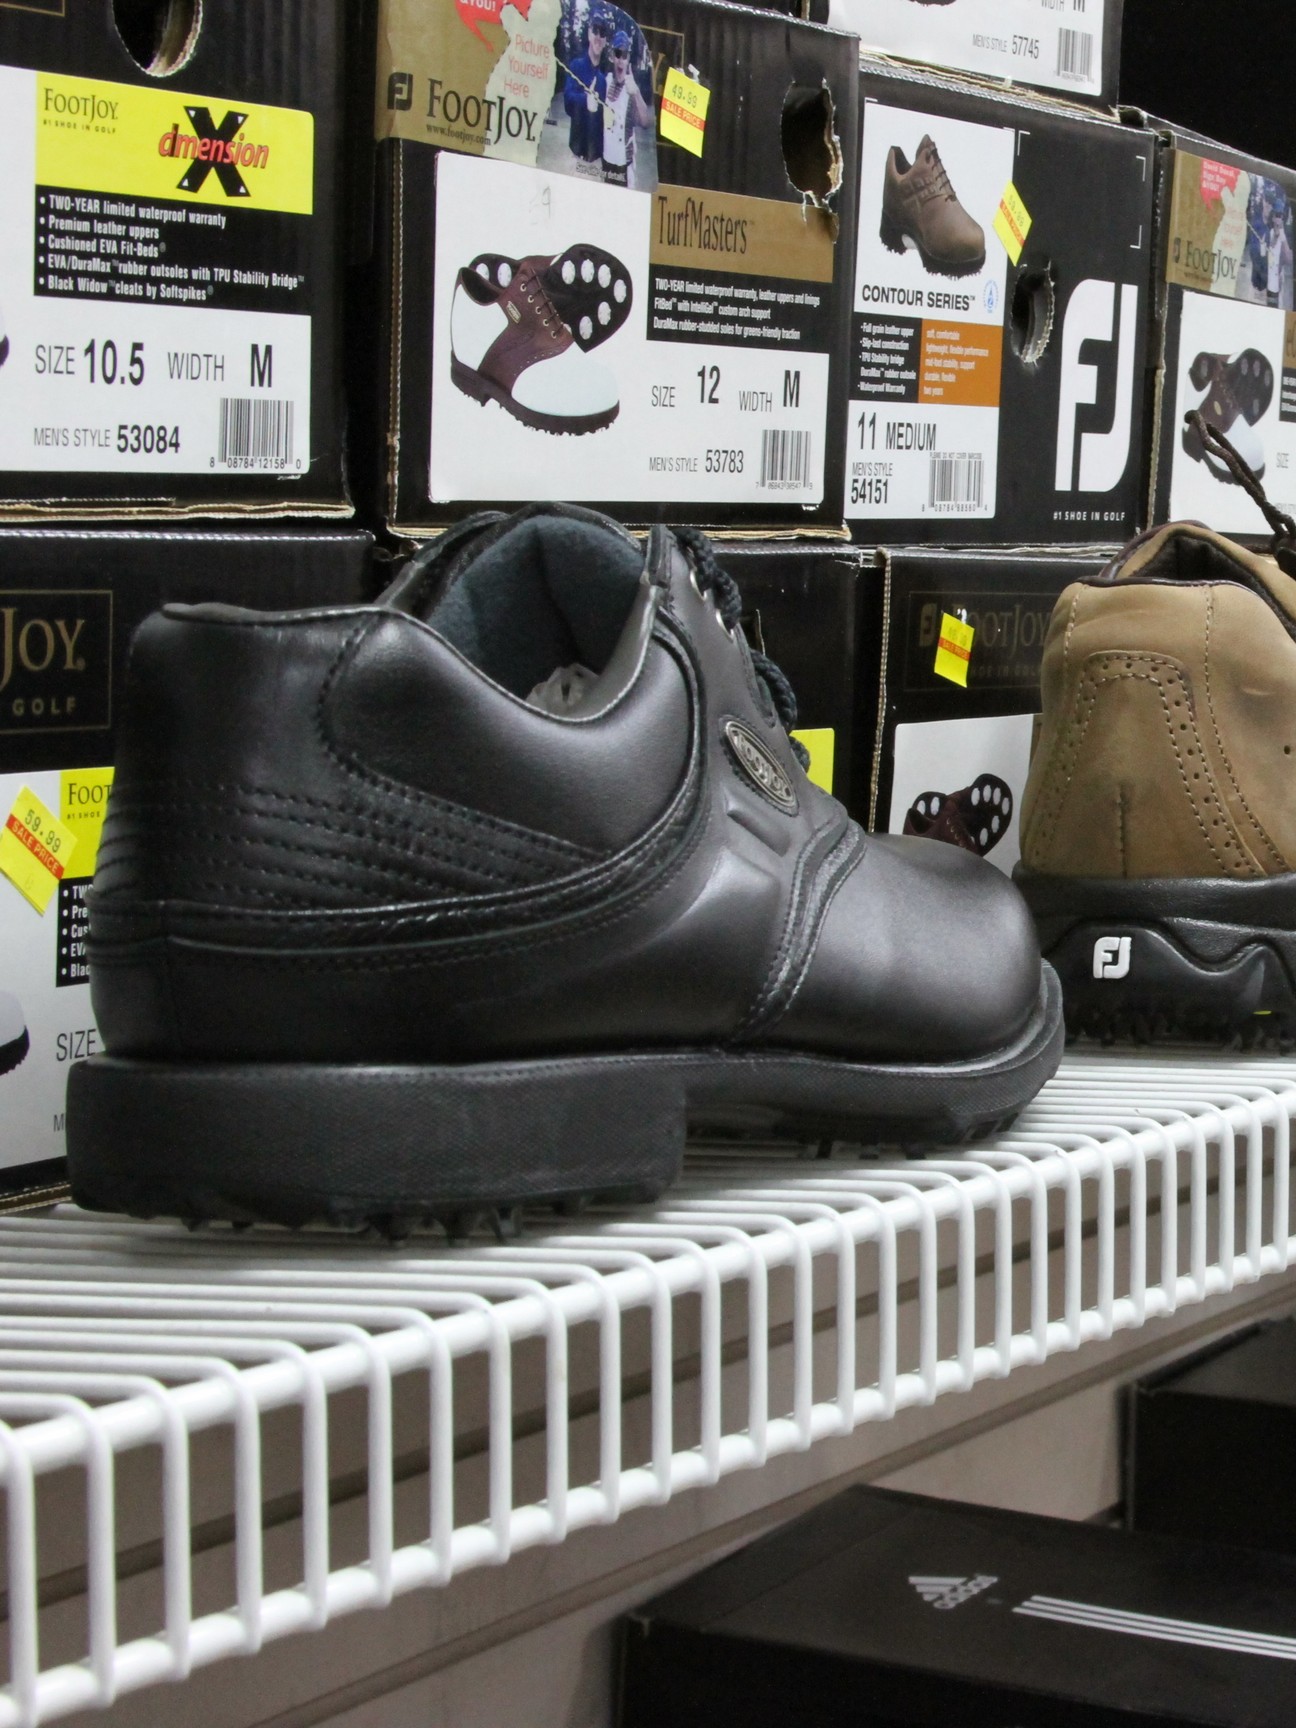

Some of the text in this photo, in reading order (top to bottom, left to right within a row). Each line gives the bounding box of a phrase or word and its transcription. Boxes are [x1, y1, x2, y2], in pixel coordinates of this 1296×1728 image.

[515, 34, 549, 58] Picture
[1011, 35, 1040, 60] 57745
[508, 56, 549, 80] Yourself
[504, 77, 530, 98] Here
[55, 120, 77, 129] SHOE
[81, 123, 91, 131] IN
[94, 125, 117, 134] GOLF
[665, 102, 701, 127] SALE PRICE
[425, 123, 491, 146] www.footjoy.com
[48, 194, 226, 230] TWO-YEAR limited waterproof warranty
[48, 214, 160, 240] Premium leather uppers
[48, 234, 96, 252] Cushioned
[100, 239, 118, 254] EVA
[119, 260, 148, 276] rubber
[150, 264, 188, 279] outsoles
[191, 266, 211, 281] with
[213, 267, 231, 283] TPU
[233, 269, 269, 288] Stability
[48, 275, 74, 291] Black
[115, 281, 143, 296] cleats
[146, 283, 157, 300] by
[655, 277, 685, 292] TWO-YEAR
[685, 281, 704, 294] limited
[704, 285, 734, 298] waterproof
[758, 289, 777, 302] leather
[777, 292, 794, 305] uppers
[862, 284, 923, 307] CONTOUR
[677, 298, 690, 311] with
[718, 305, 738, 316] custom
[738, 307, 750, 317] arch
[751, 308, 771, 320] support
[34, 338, 273, 388] SIZE 10.5 WIDTH M
[651, 365, 800, 412] SIZE 12 WIDTH M
[1055, 278, 1138, 492] FJ
[33, 424, 180, 453] MEN'S STYLE 53084
[858, 411, 937, 451] 11 MEDIUM
[227, 456, 254, 468] 08784
[258, 456, 285, 469] 12158
[649, 449, 744, 473] MEN'S STYLE 53783
[851, 462, 893, 504] MEN'S STYLE 54151
[1064, 511, 1088, 521] SHOE
[1091, 511, 1100, 521] IN
[1103, 511, 1125, 521] GOLF
[79, 811, 100, 819] SHOE
[25, 809, 61, 853] 59.99
[11, 821, 59, 873] SALE PRICE
[1093, 936, 1132, 979] FJ
[56, 1028, 97, 1062] SIZE
